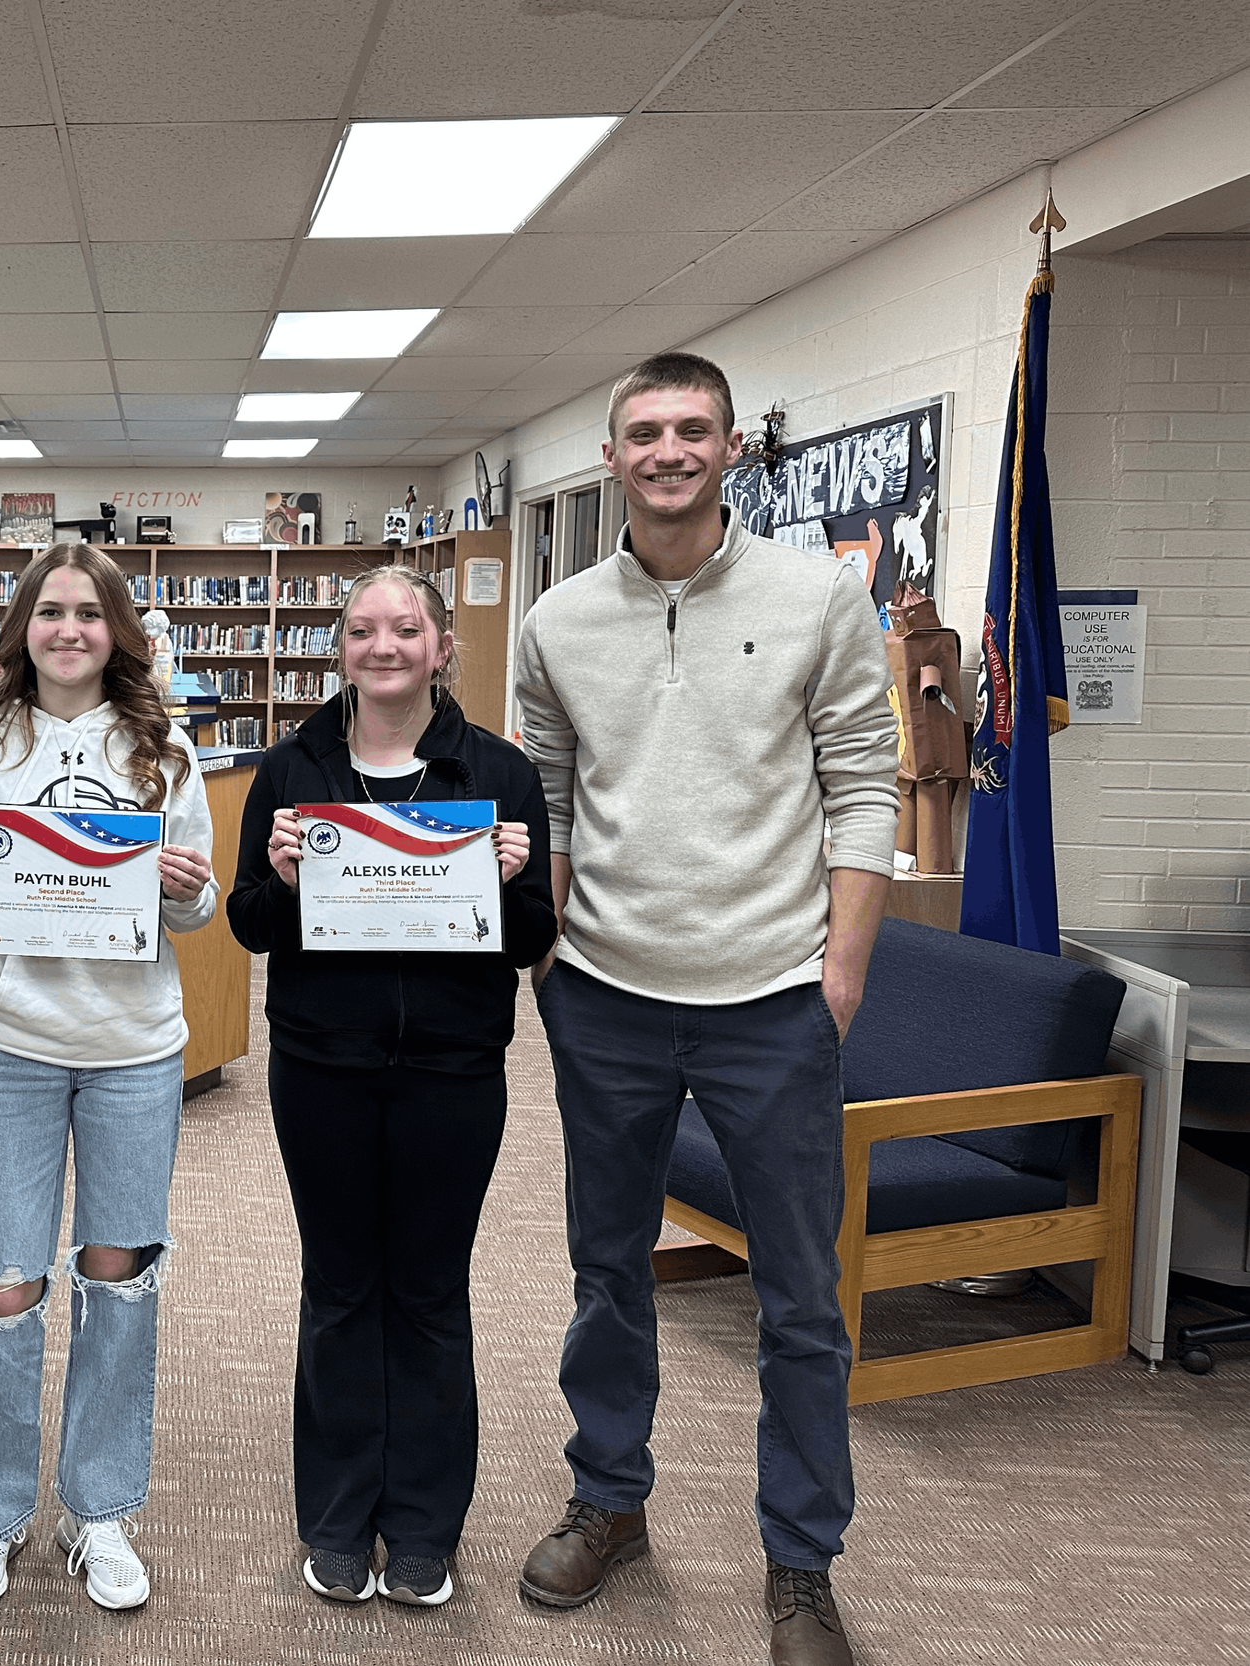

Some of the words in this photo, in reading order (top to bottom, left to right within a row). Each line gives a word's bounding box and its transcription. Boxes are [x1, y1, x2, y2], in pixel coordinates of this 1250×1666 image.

[785, 428, 887, 523] NEWS
[111, 491, 202, 507] FICTION
[1064, 612, 1130, 621] COMPUTER
[1084, 624, 1108, 634] USE
[1063, 645, 1136, 654] DUCATIONAL
[996, 692, 1006, 725] UNUM
[342, 865, 397, 877] ALEXIS
[401, 864, 450, 876] KELLY
[14, 872, 64, 886] PAYTN
[68, 875, 111, 887] BUHL
